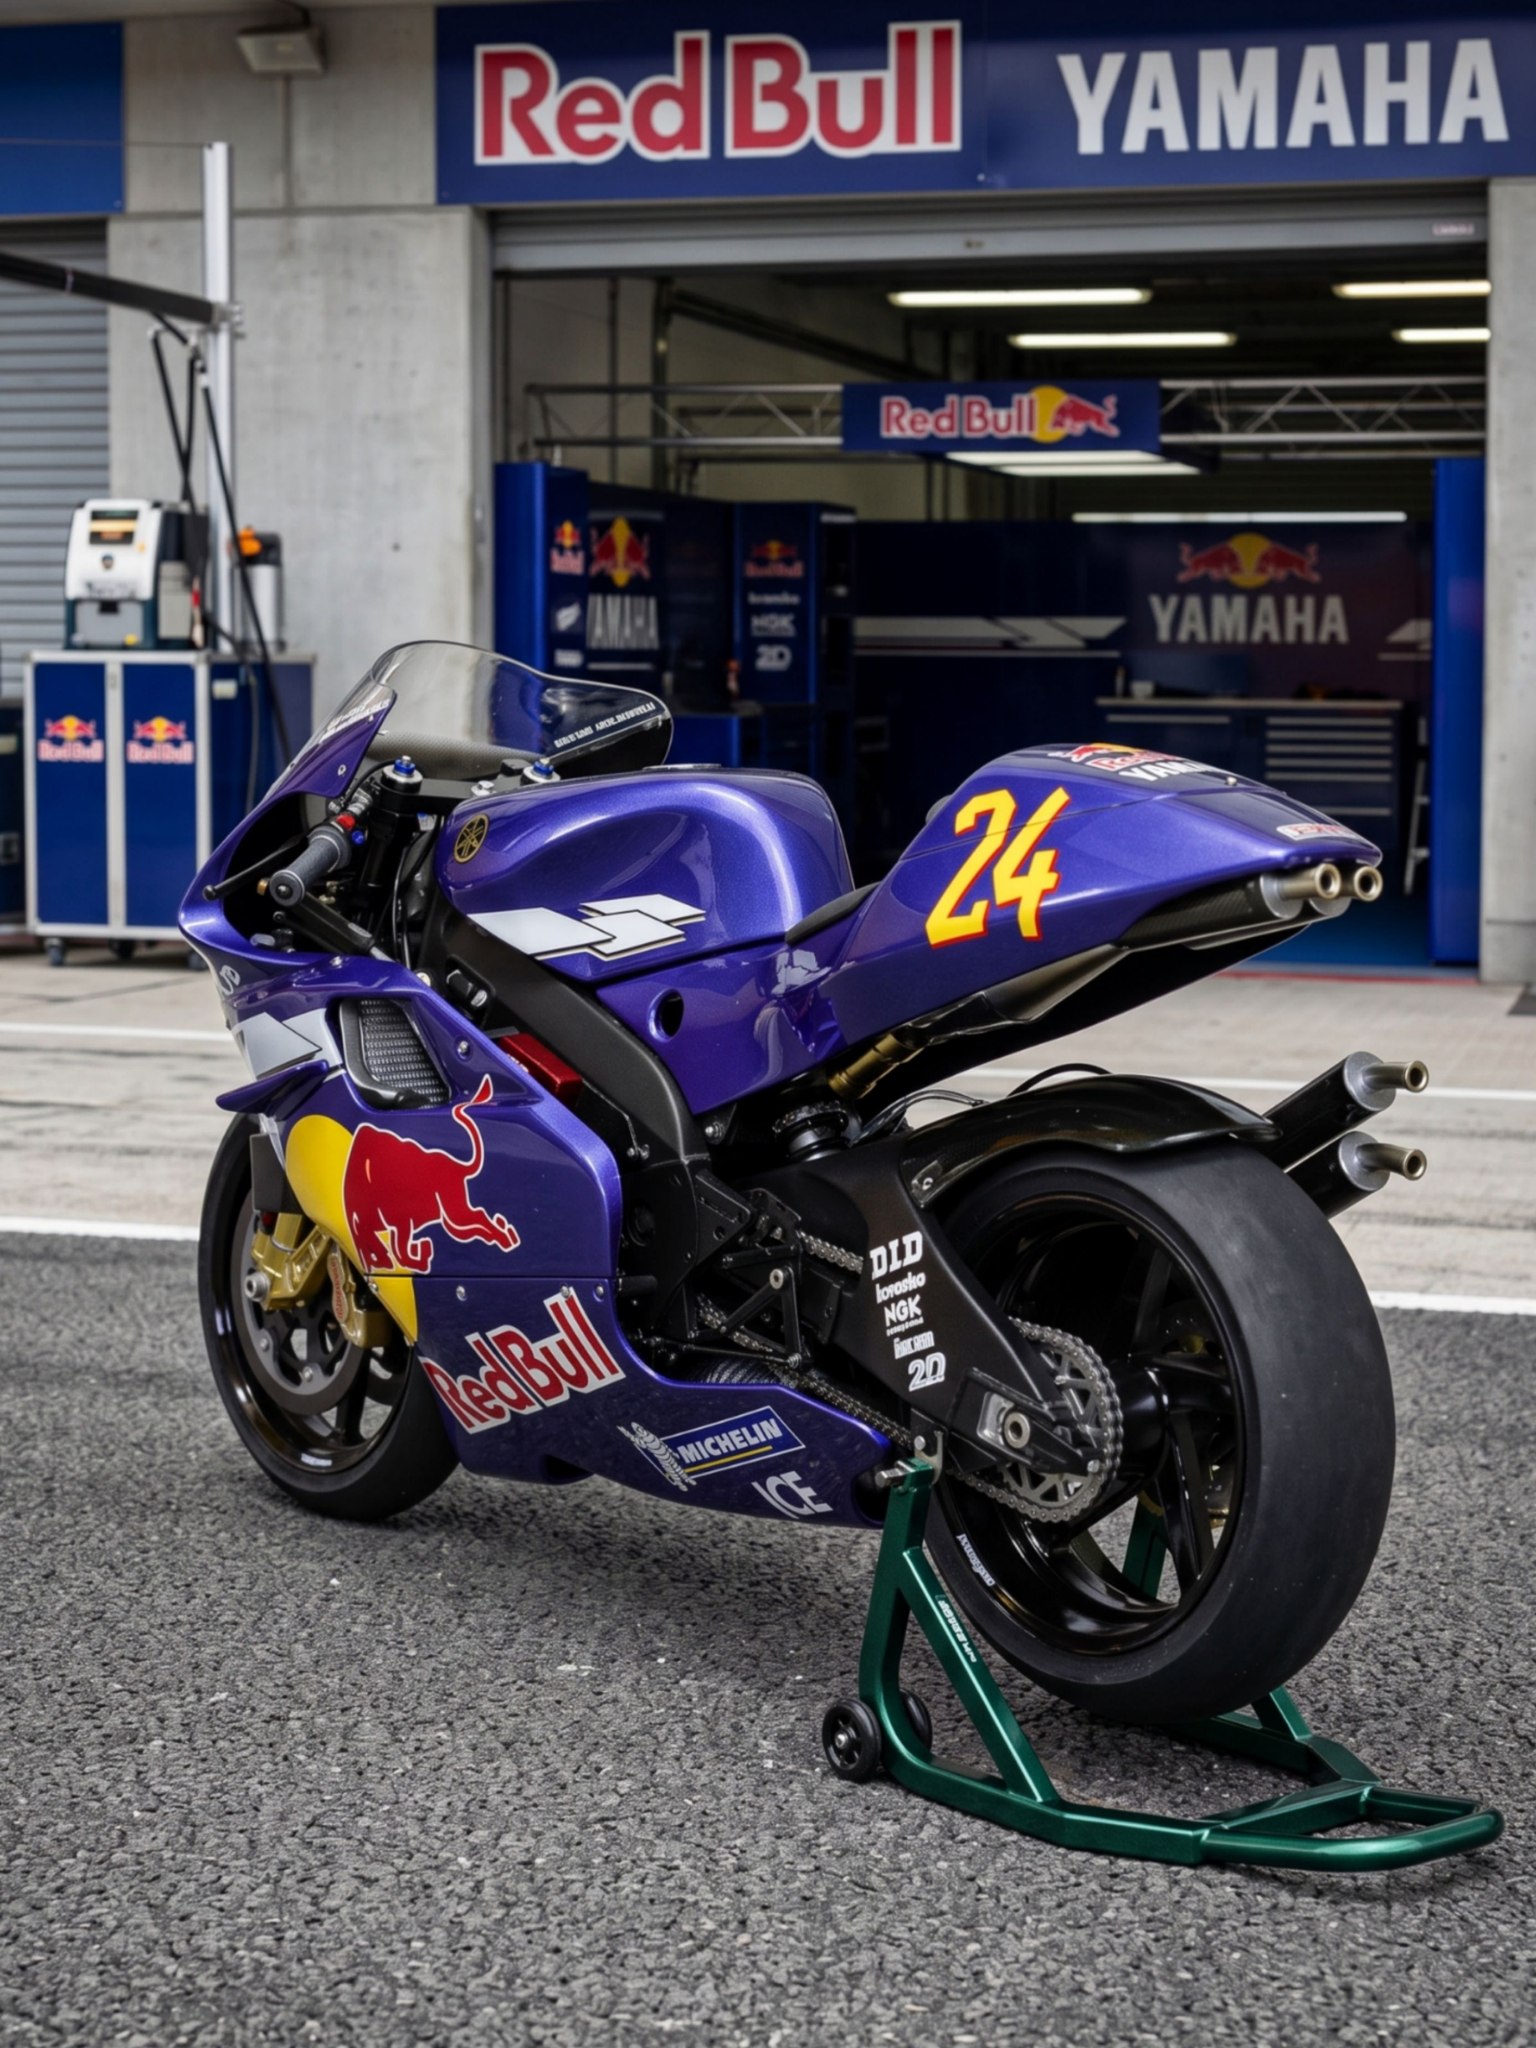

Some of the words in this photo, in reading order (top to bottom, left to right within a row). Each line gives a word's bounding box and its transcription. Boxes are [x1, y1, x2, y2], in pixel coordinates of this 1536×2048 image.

[475, 30, 709, 165] Red
[725, 20, 961, 158] Bull
[1056, 38, 1510, 155] YAMAHA
[881, 394, 958, 439] Red
[962, 393, 1037, 439] Bull
[1149, 594, 1349, 644] YAMAHA
[925, 786, 1072, 949] 24
[884, 1293, 923, 1328] NGK
[418, 1331, 544, 1435] Red
[485, 1286, 627, 1408] Bull
[677, 1418, 783, 1464] MICHELIN
